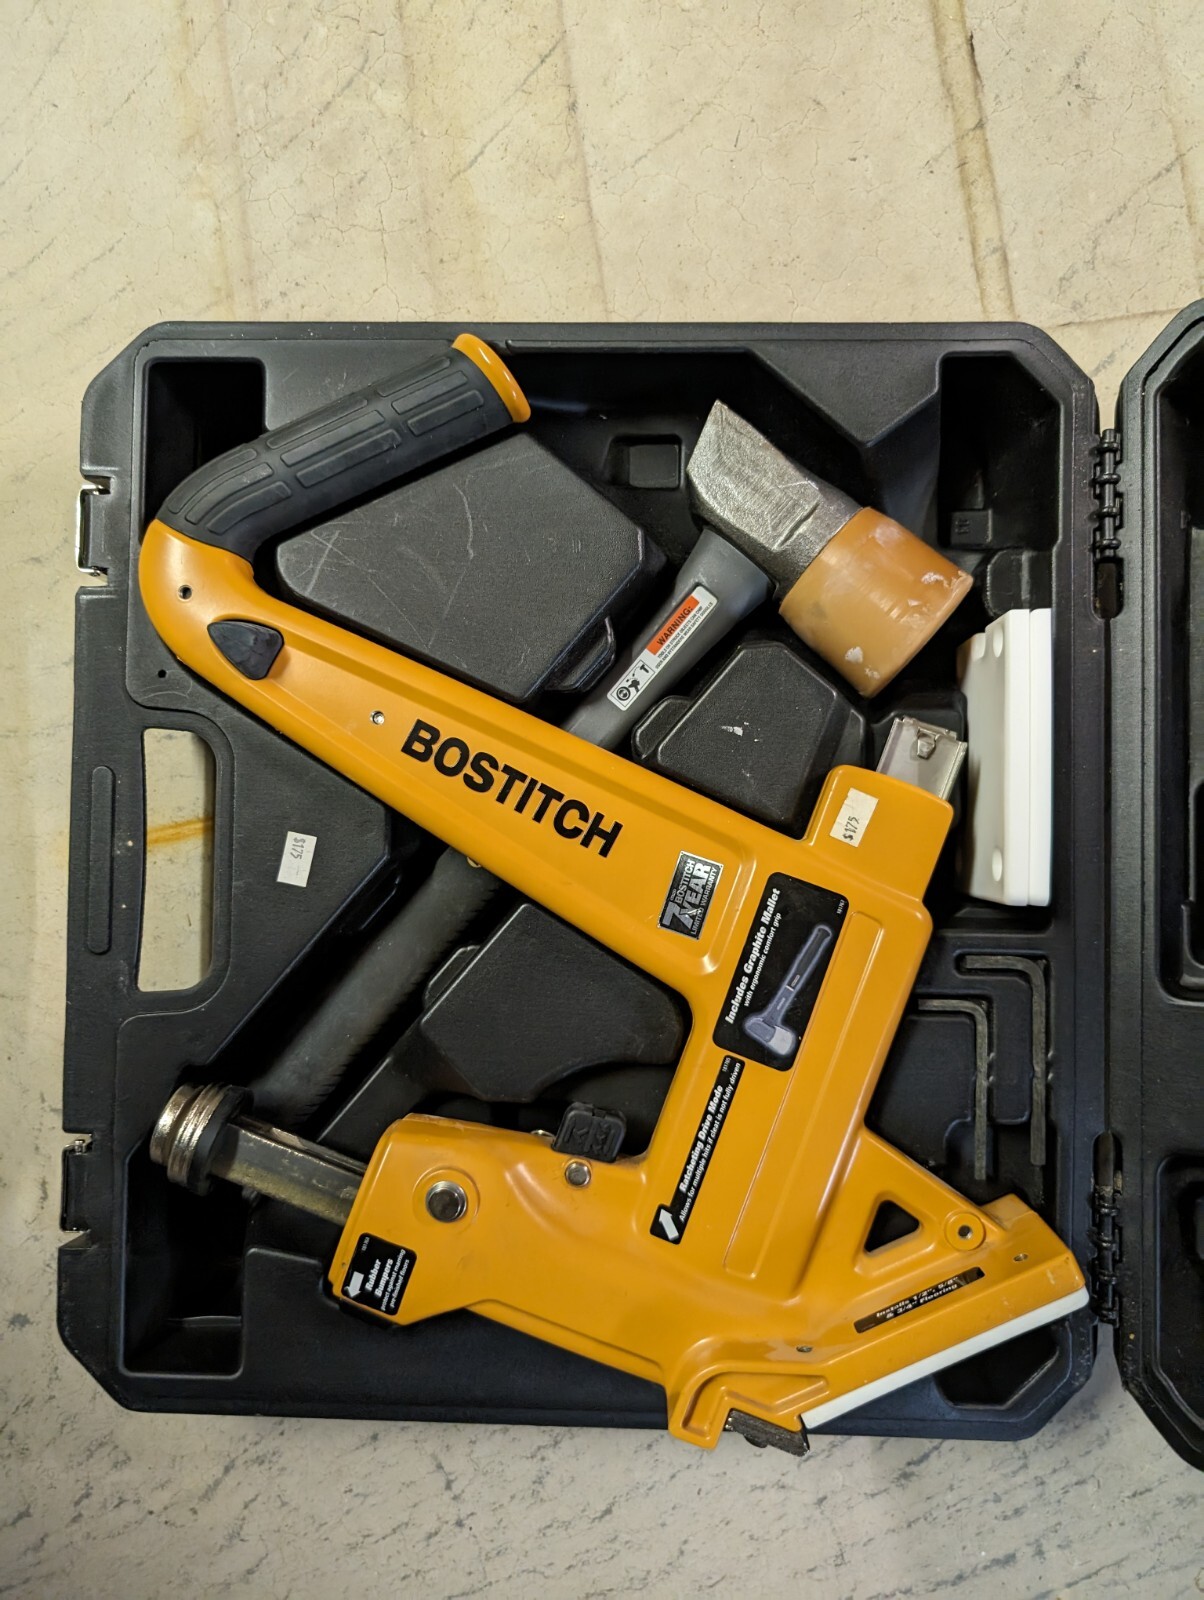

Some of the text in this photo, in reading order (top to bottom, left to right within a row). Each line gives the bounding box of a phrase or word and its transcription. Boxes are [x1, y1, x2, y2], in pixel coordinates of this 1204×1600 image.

[656, 606, 693, 646] WARNING:
[401, 719, 623, 858] BOSTITCH
[675, 858, 696, 904] BOSTITCH
[680, 861, 712, 918] YEAR
[700, 866, 718, 906] WARRANTY
[662, 901, 698, 930] 7
[724, 888, 781, 1024] Includes Graphite Mallet
[743, 912, 782, 1007] with ergonomic comfort grip
[678, 1085, 724, 1193] Ratcheting Drive Mode
[678, 1062, 741, 1222] Allows for multiple hits if cleat is not fully driven
[364, 1258, 382, 1292] Rubber
[374, 1258, 394, 1298] Bumpers
[380, 1248, 406, 1312] protect against marring
[399, 1259, 410, 1276] floors
[876, 1300, 910, 1318] Installs
[919, 1283, 958, 1304] Flooring
